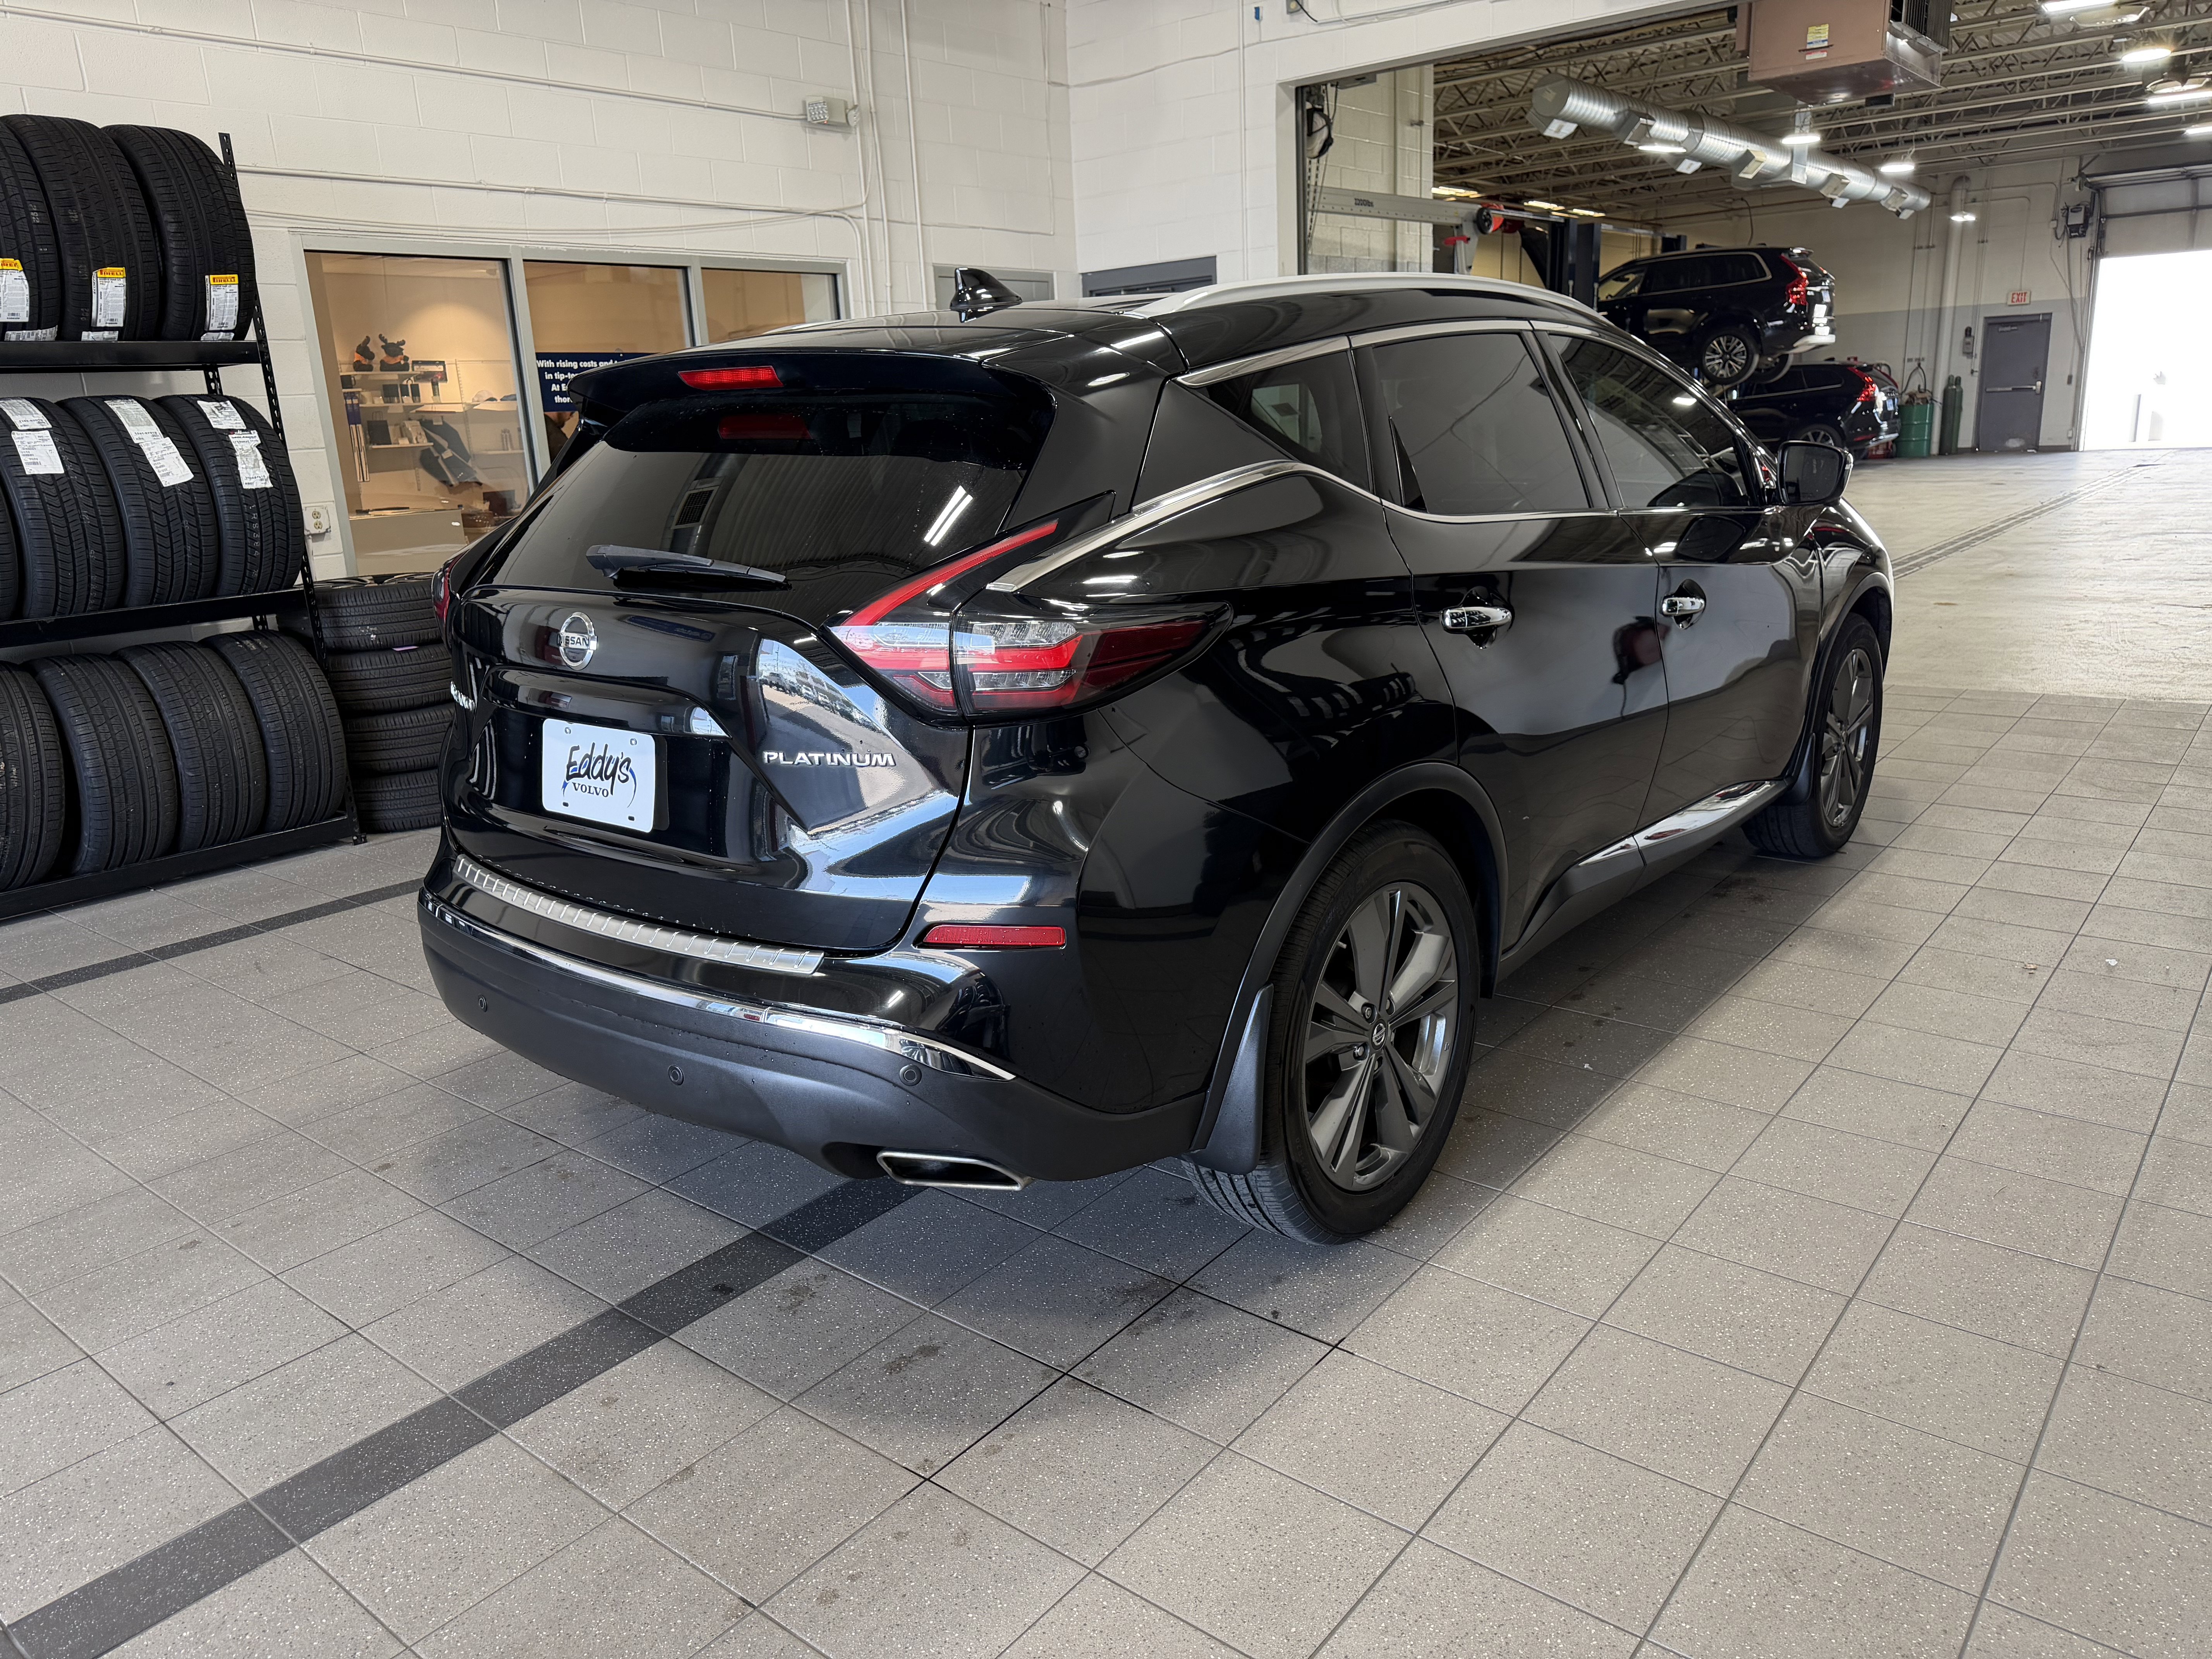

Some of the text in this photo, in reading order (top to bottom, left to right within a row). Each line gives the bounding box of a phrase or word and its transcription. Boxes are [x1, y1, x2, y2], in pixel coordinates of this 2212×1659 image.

[2011, 292, 2027, 303] EXIT
[556, 360, 578, 369] rising
[557, 633, 590, 647] NISSAN
[763, 751, 896, 767] PLATINUM
[566, 742, 632, 795] Eddy's
[572, 782, 609, 797] VOLVO
